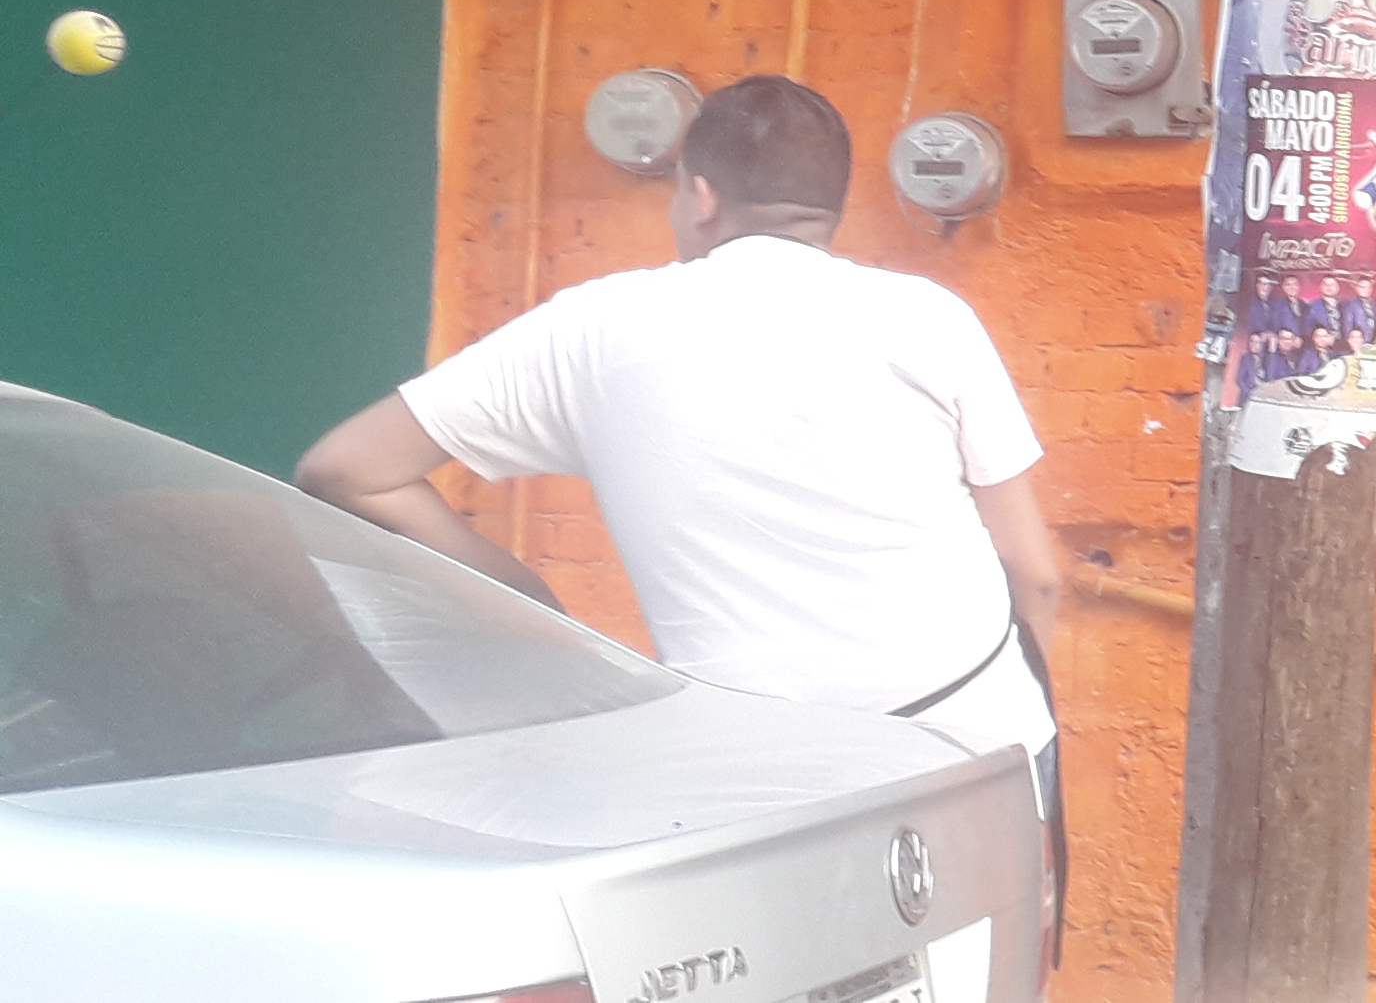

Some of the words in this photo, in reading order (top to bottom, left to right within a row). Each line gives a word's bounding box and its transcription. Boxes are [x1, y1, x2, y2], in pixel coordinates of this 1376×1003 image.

[1264, 119, 1335, 152] MAYO
[1244, 152, 1307, 222] 04
[1308, 155, 1334, 182] PM
[626, 945, 751, 1003] JETTA
